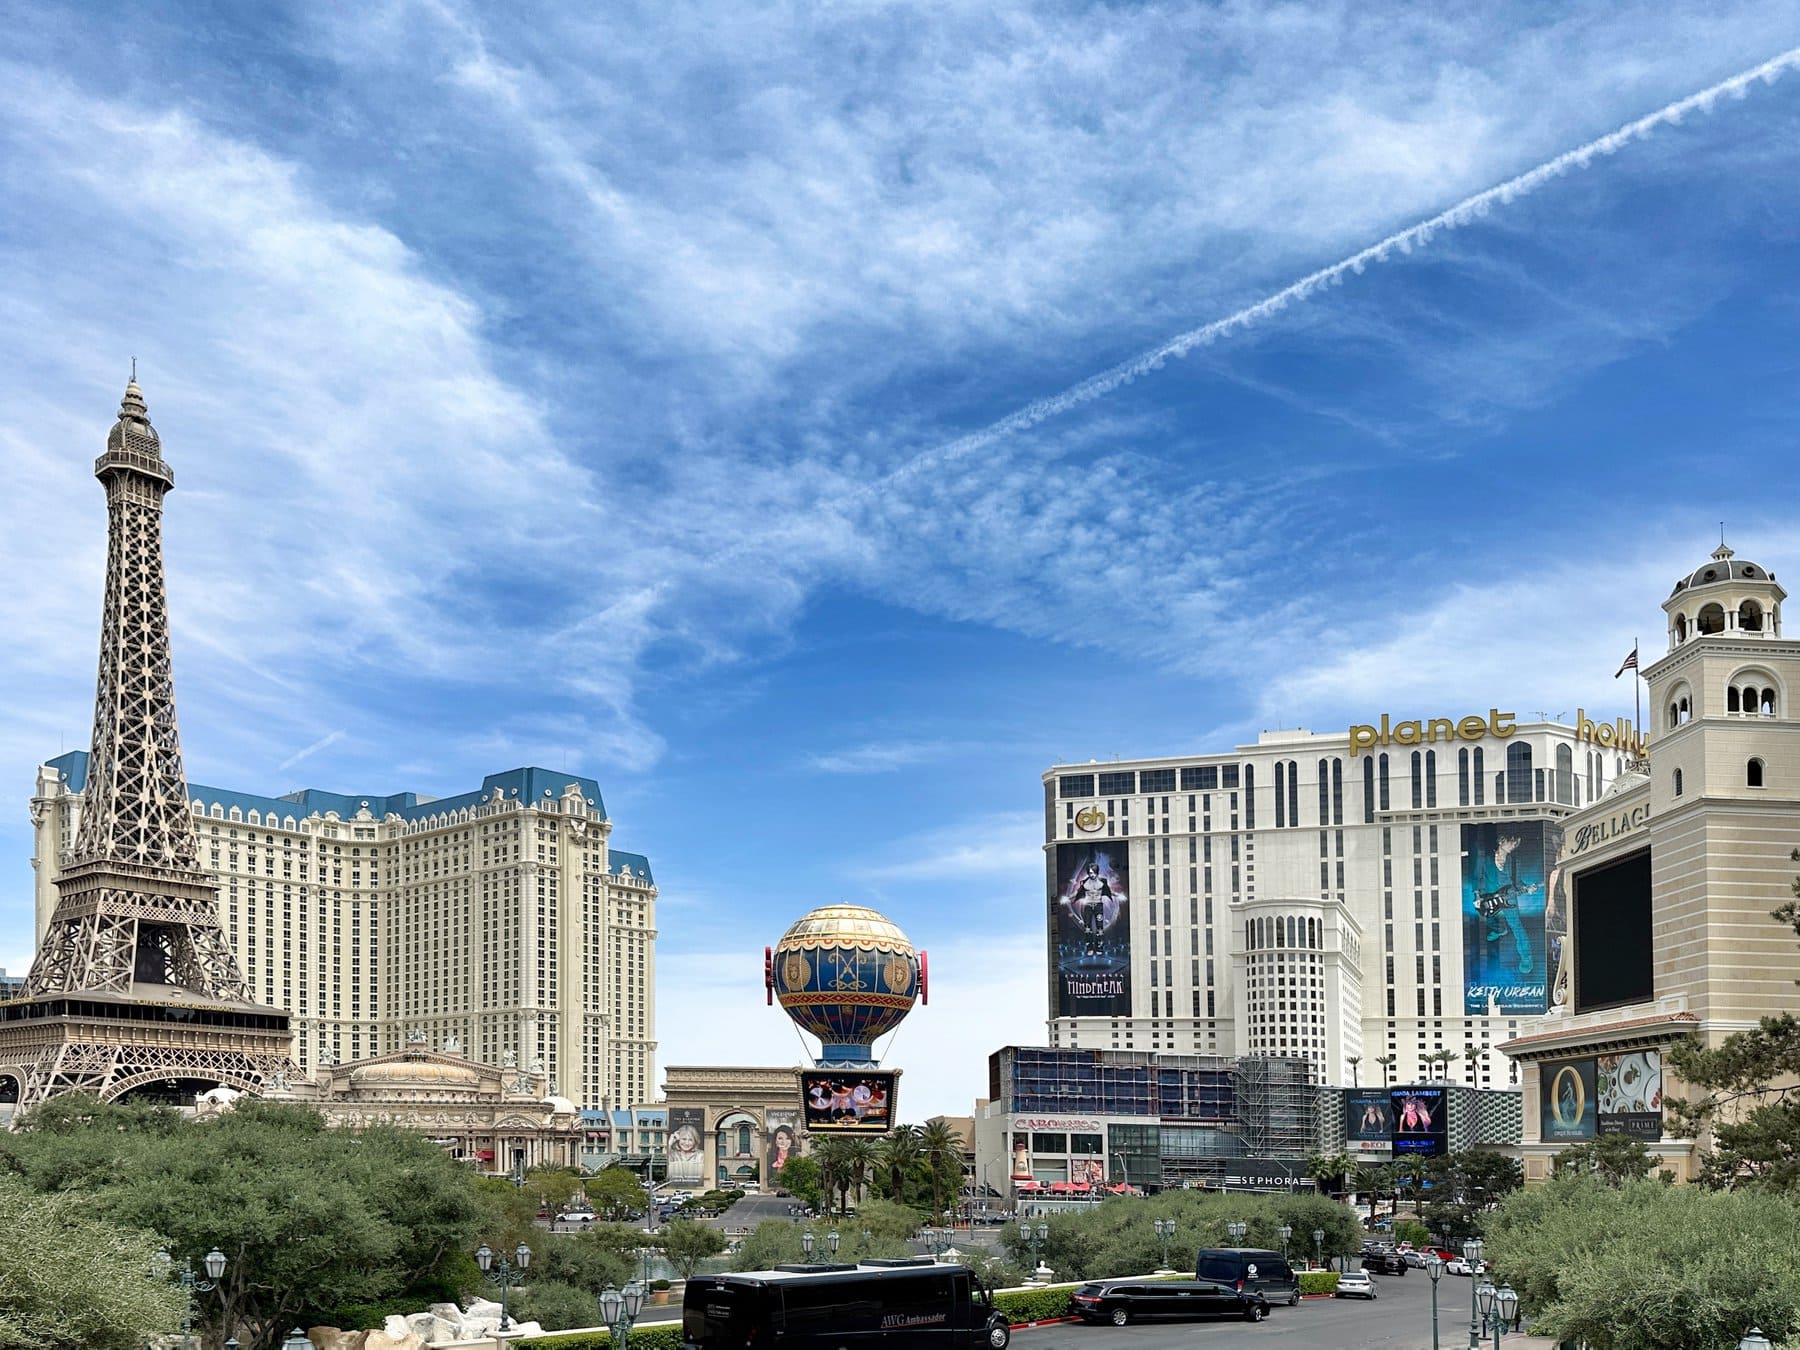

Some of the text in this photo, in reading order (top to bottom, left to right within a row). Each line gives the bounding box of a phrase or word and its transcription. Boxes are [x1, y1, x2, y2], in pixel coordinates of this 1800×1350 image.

[1350, 708, 1517, 757] planet
[1079, 806, 1105, 828] ph
[1067, 980, 1124, 995] MINDFREAK
[1467, 984, 1545, 998] KEITH URBAN
[1631, 1121, 1654, 1131] PRIME
[1242, 1176, 1300, 1186] SEPHORA
[881, 1314, 904, 1327] AWG
